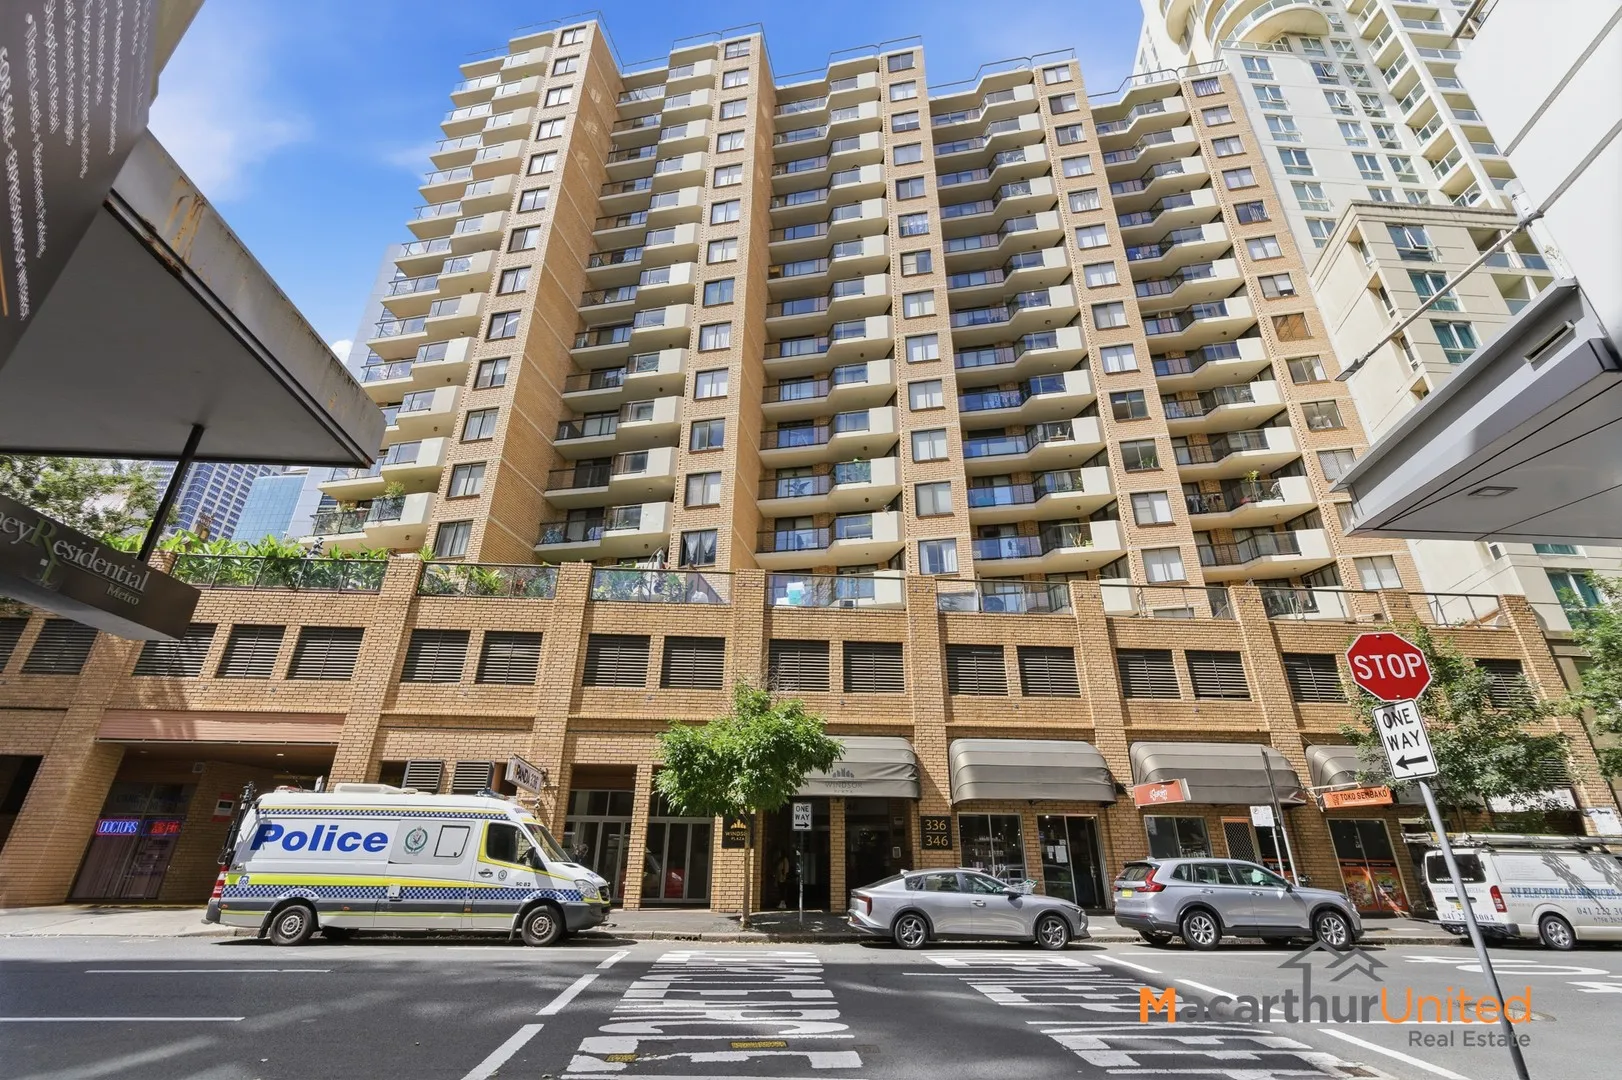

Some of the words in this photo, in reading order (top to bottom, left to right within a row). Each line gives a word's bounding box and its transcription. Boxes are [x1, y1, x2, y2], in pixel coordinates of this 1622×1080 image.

[106, 583, 140, 607] Metro
[1353, 652, 1422, 680] STOP
[1382, 707, 1414, 729] ONE
[1386, 729, 1421, 751] WAY
[1340, 793, 1356, 801] TOKO
[1356, 789, 1388, 800] SEMBAKO
[795, 805, 810, 813] ONE
[795, 813, 810, 821] WAY
[925, 819, 947, 831] 336
[249, 824, 389, 852] Police
[926, 835, 949, 847] 346
